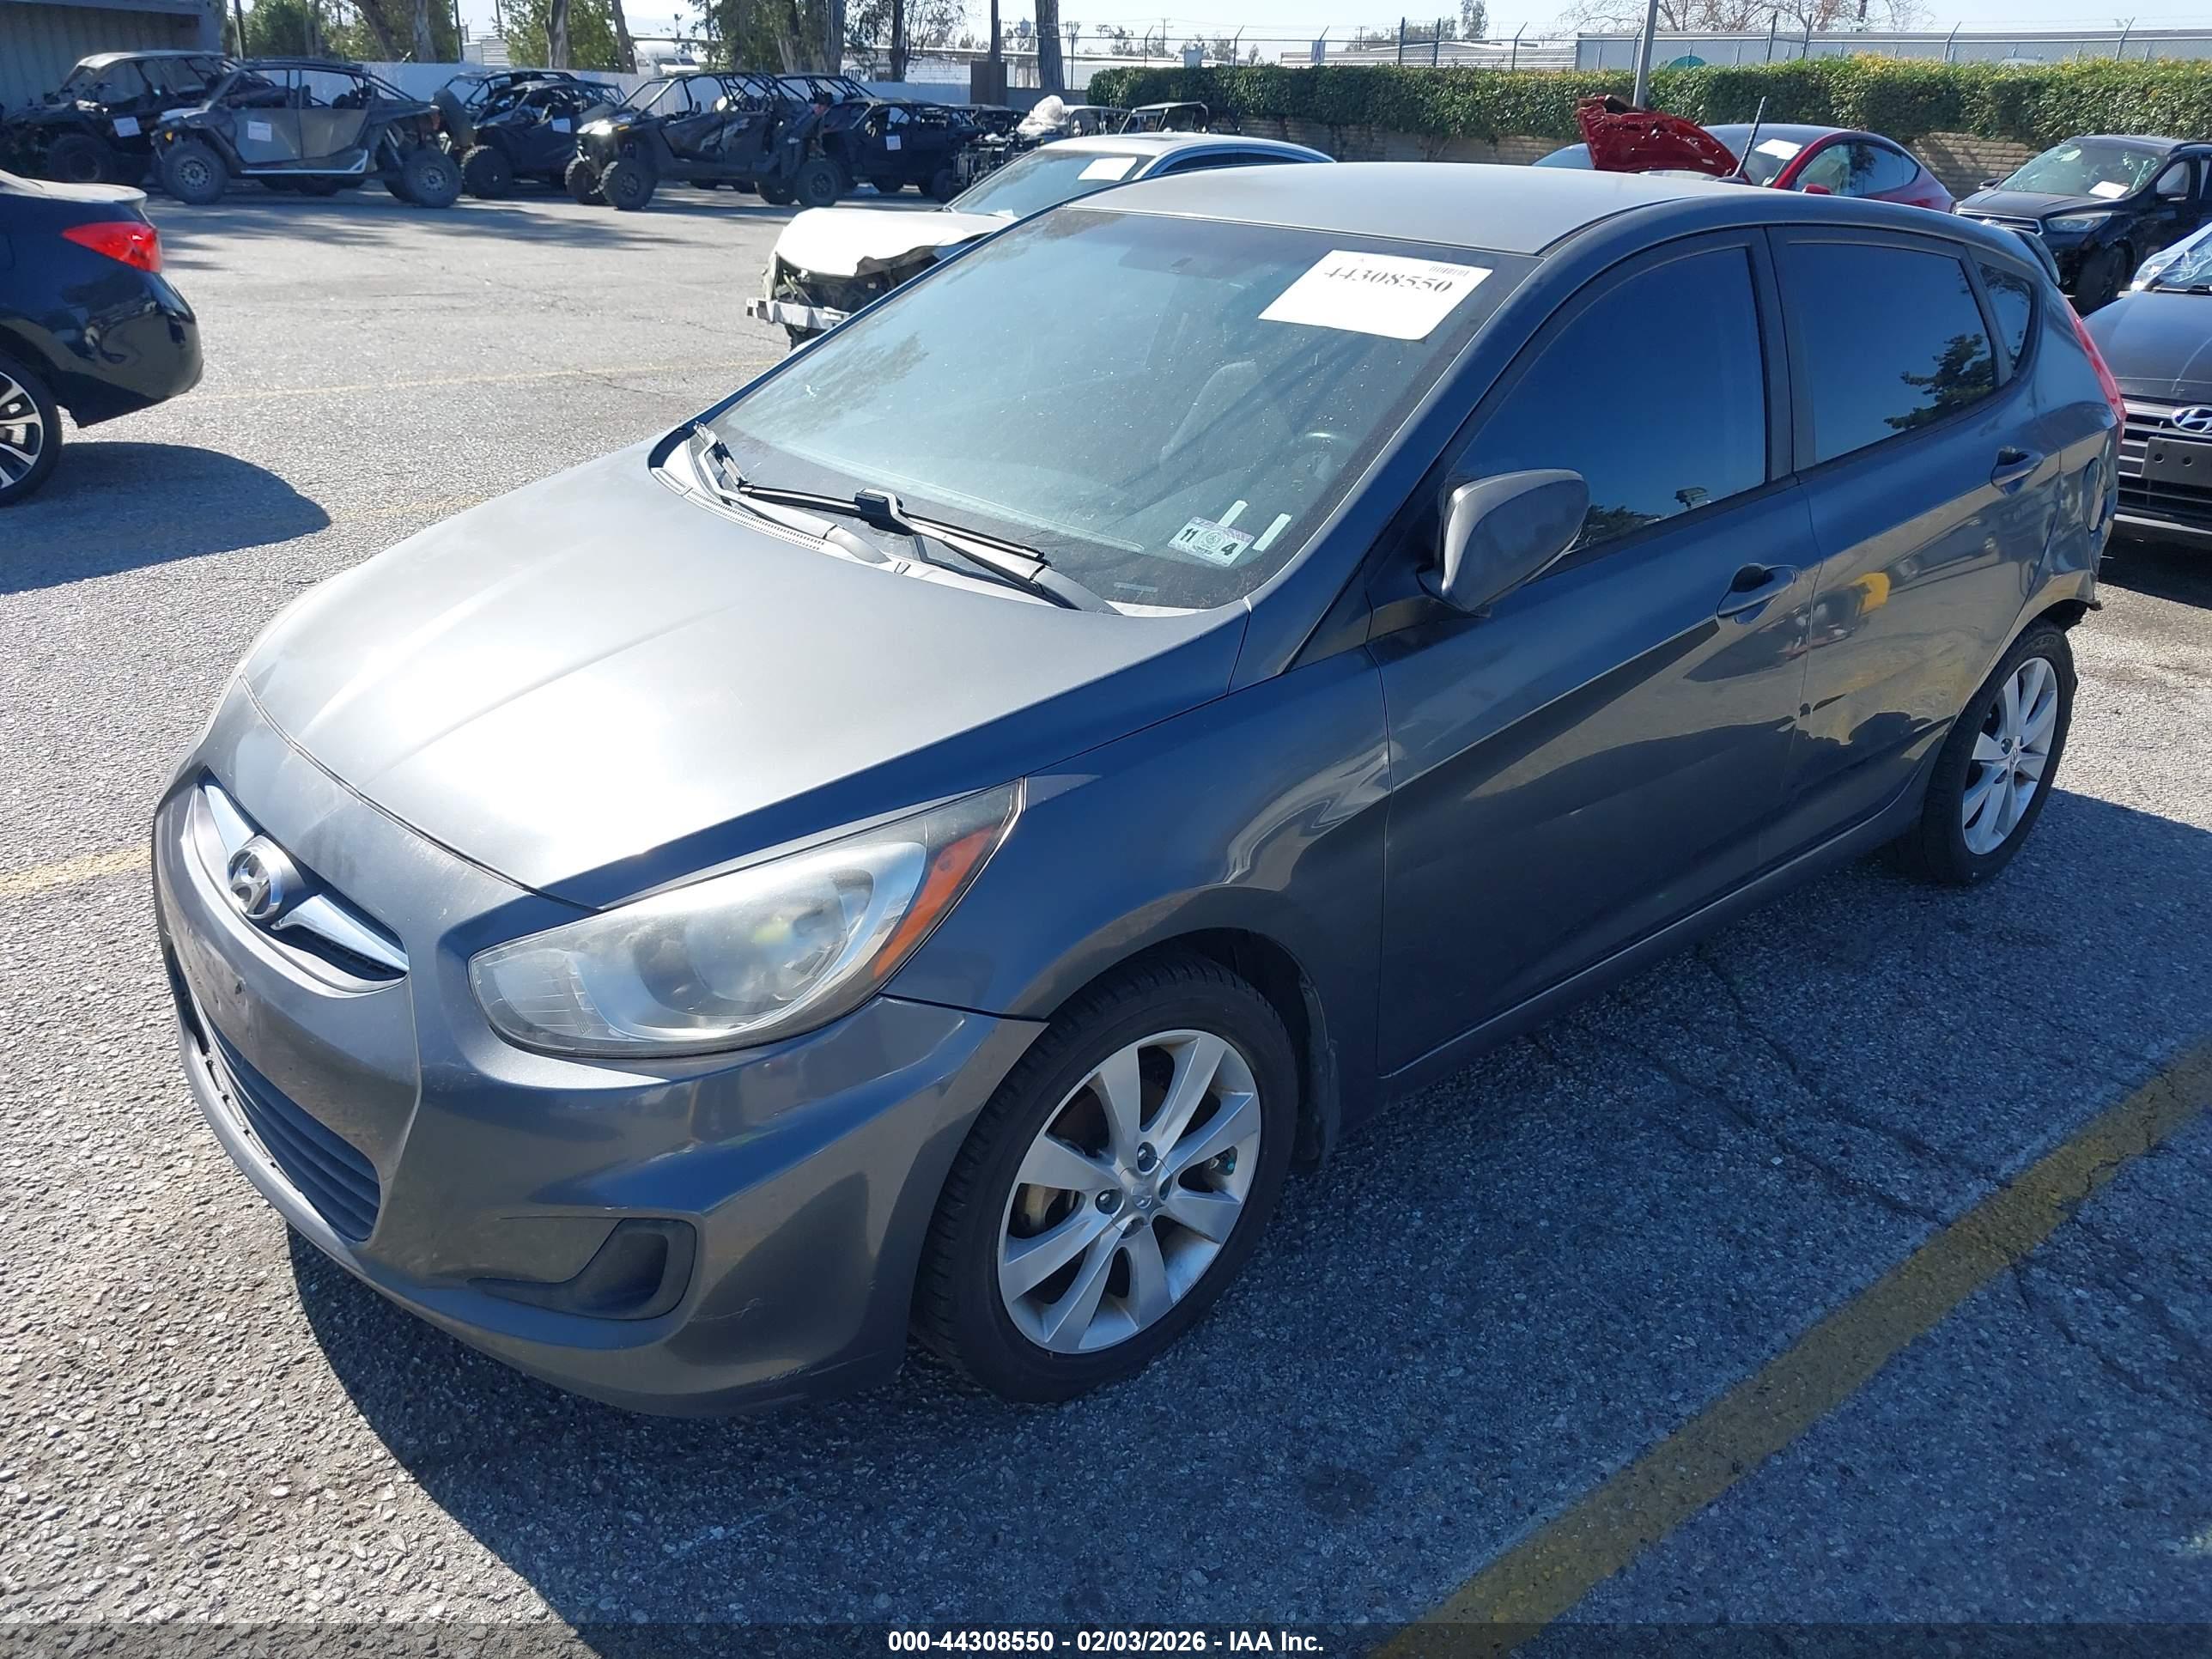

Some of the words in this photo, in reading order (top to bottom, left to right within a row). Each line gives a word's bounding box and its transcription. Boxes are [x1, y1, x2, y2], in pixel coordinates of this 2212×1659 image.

[1323, 265, 1453, 294] 44308550
[1180, 527, 1199, 544] 11
[1220, 542, 1239, 556] 4
